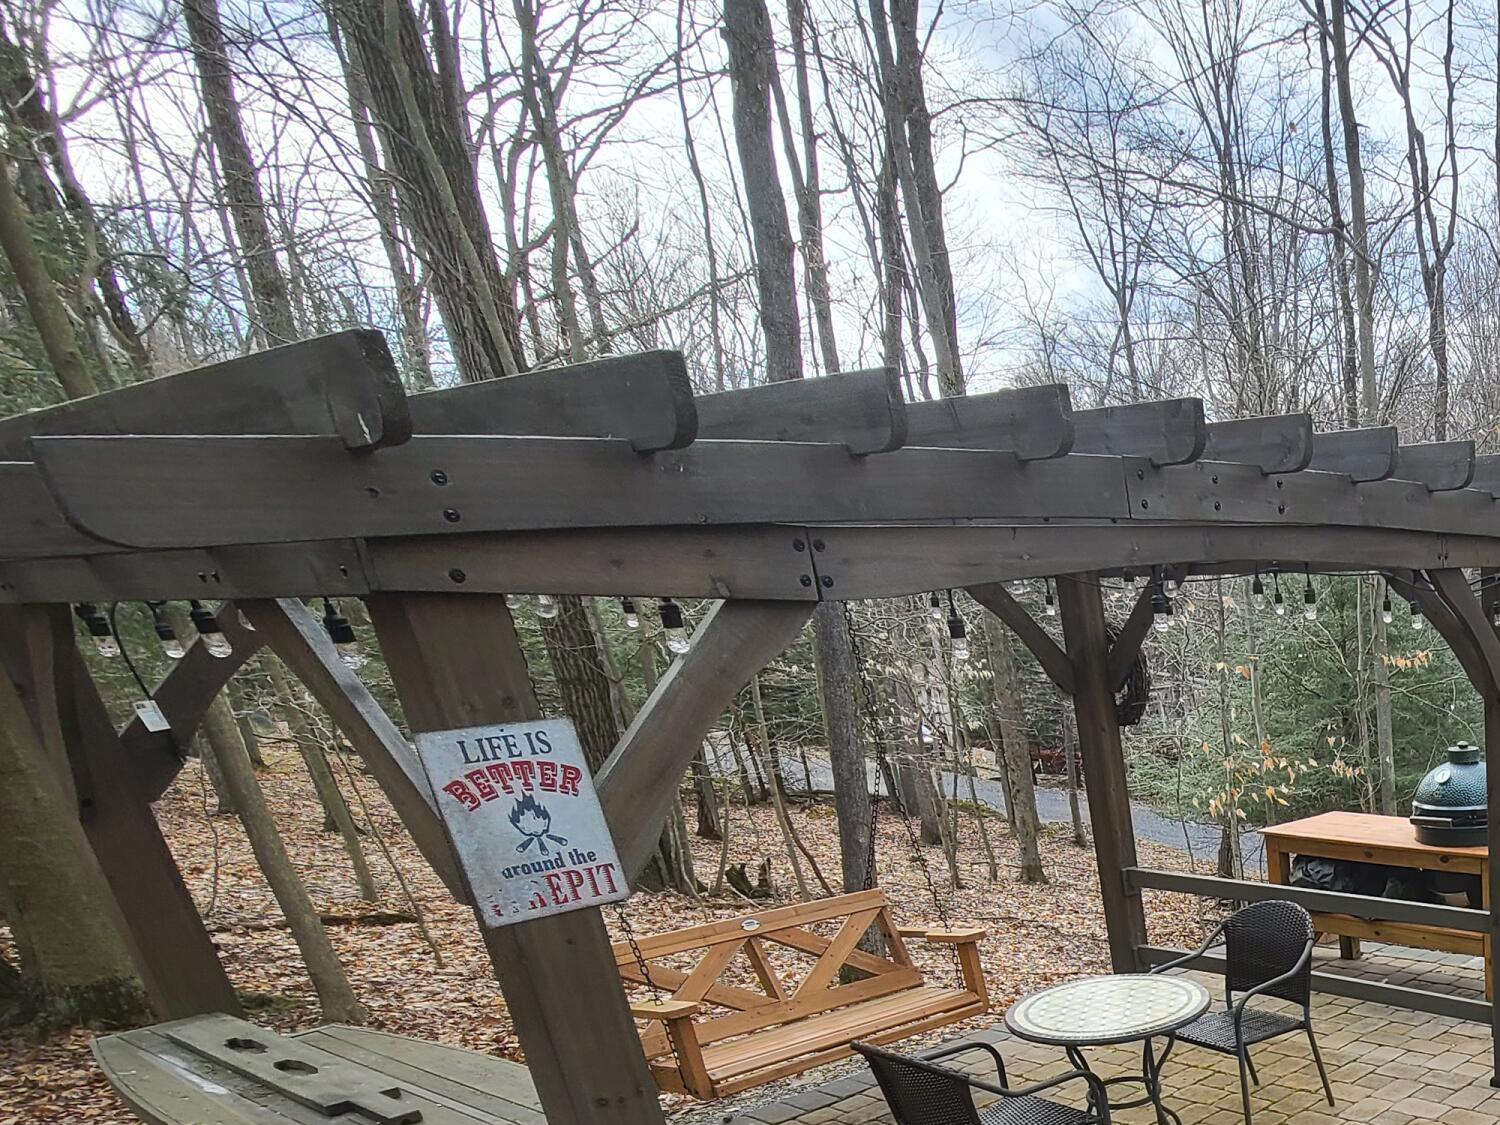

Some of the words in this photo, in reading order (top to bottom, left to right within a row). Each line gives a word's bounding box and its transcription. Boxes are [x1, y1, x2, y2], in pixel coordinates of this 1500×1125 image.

[457, 734, 523, 764] LIFE
[524, 730, 552, 756] IS
[442, 760, 582, 812] BETTER
[501, 852, 566, 879] around
[567, 848, 598, 866] the
[487, 863, 618, 917] EPIT
